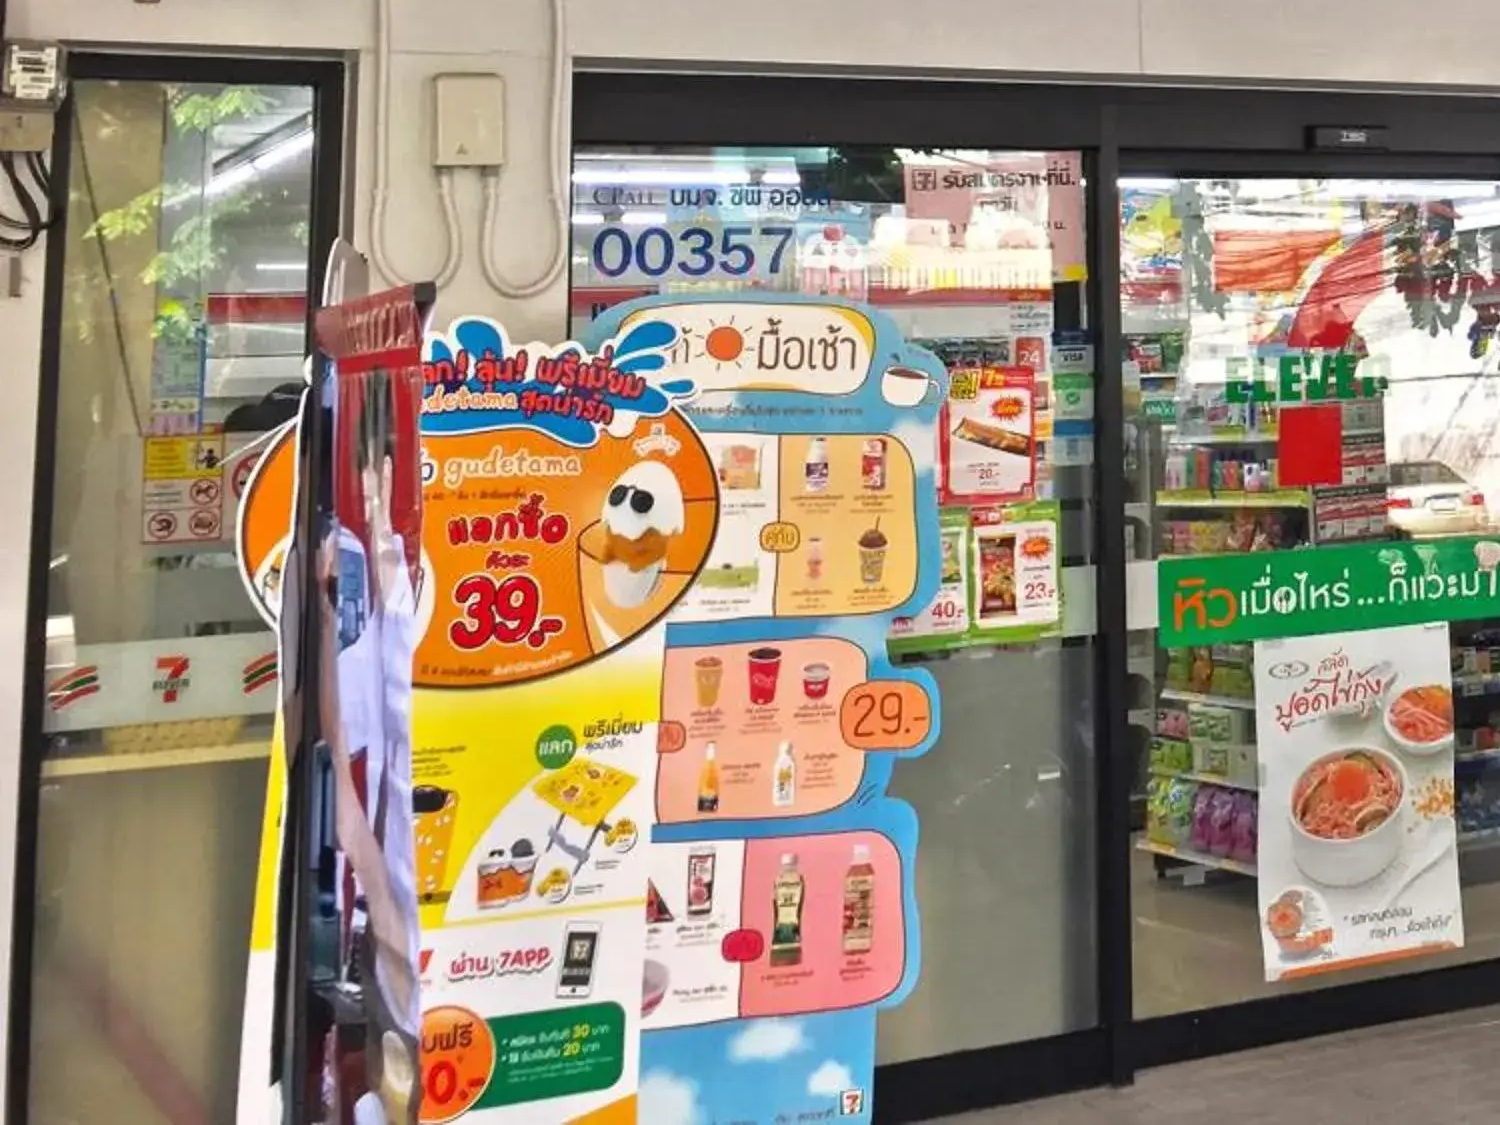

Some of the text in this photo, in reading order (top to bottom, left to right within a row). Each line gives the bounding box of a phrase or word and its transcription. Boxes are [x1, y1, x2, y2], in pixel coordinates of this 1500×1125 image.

[592, 226, 794, 278] 00357
[756, 316, 857, 372] มื้อเช้า
[446, 444, 582, 487] gudetama
[449, 573, 564, 650] 39.-
[853, 692, 928, 739] 29.-
[450, 948, 489, 975] ผ่าน
